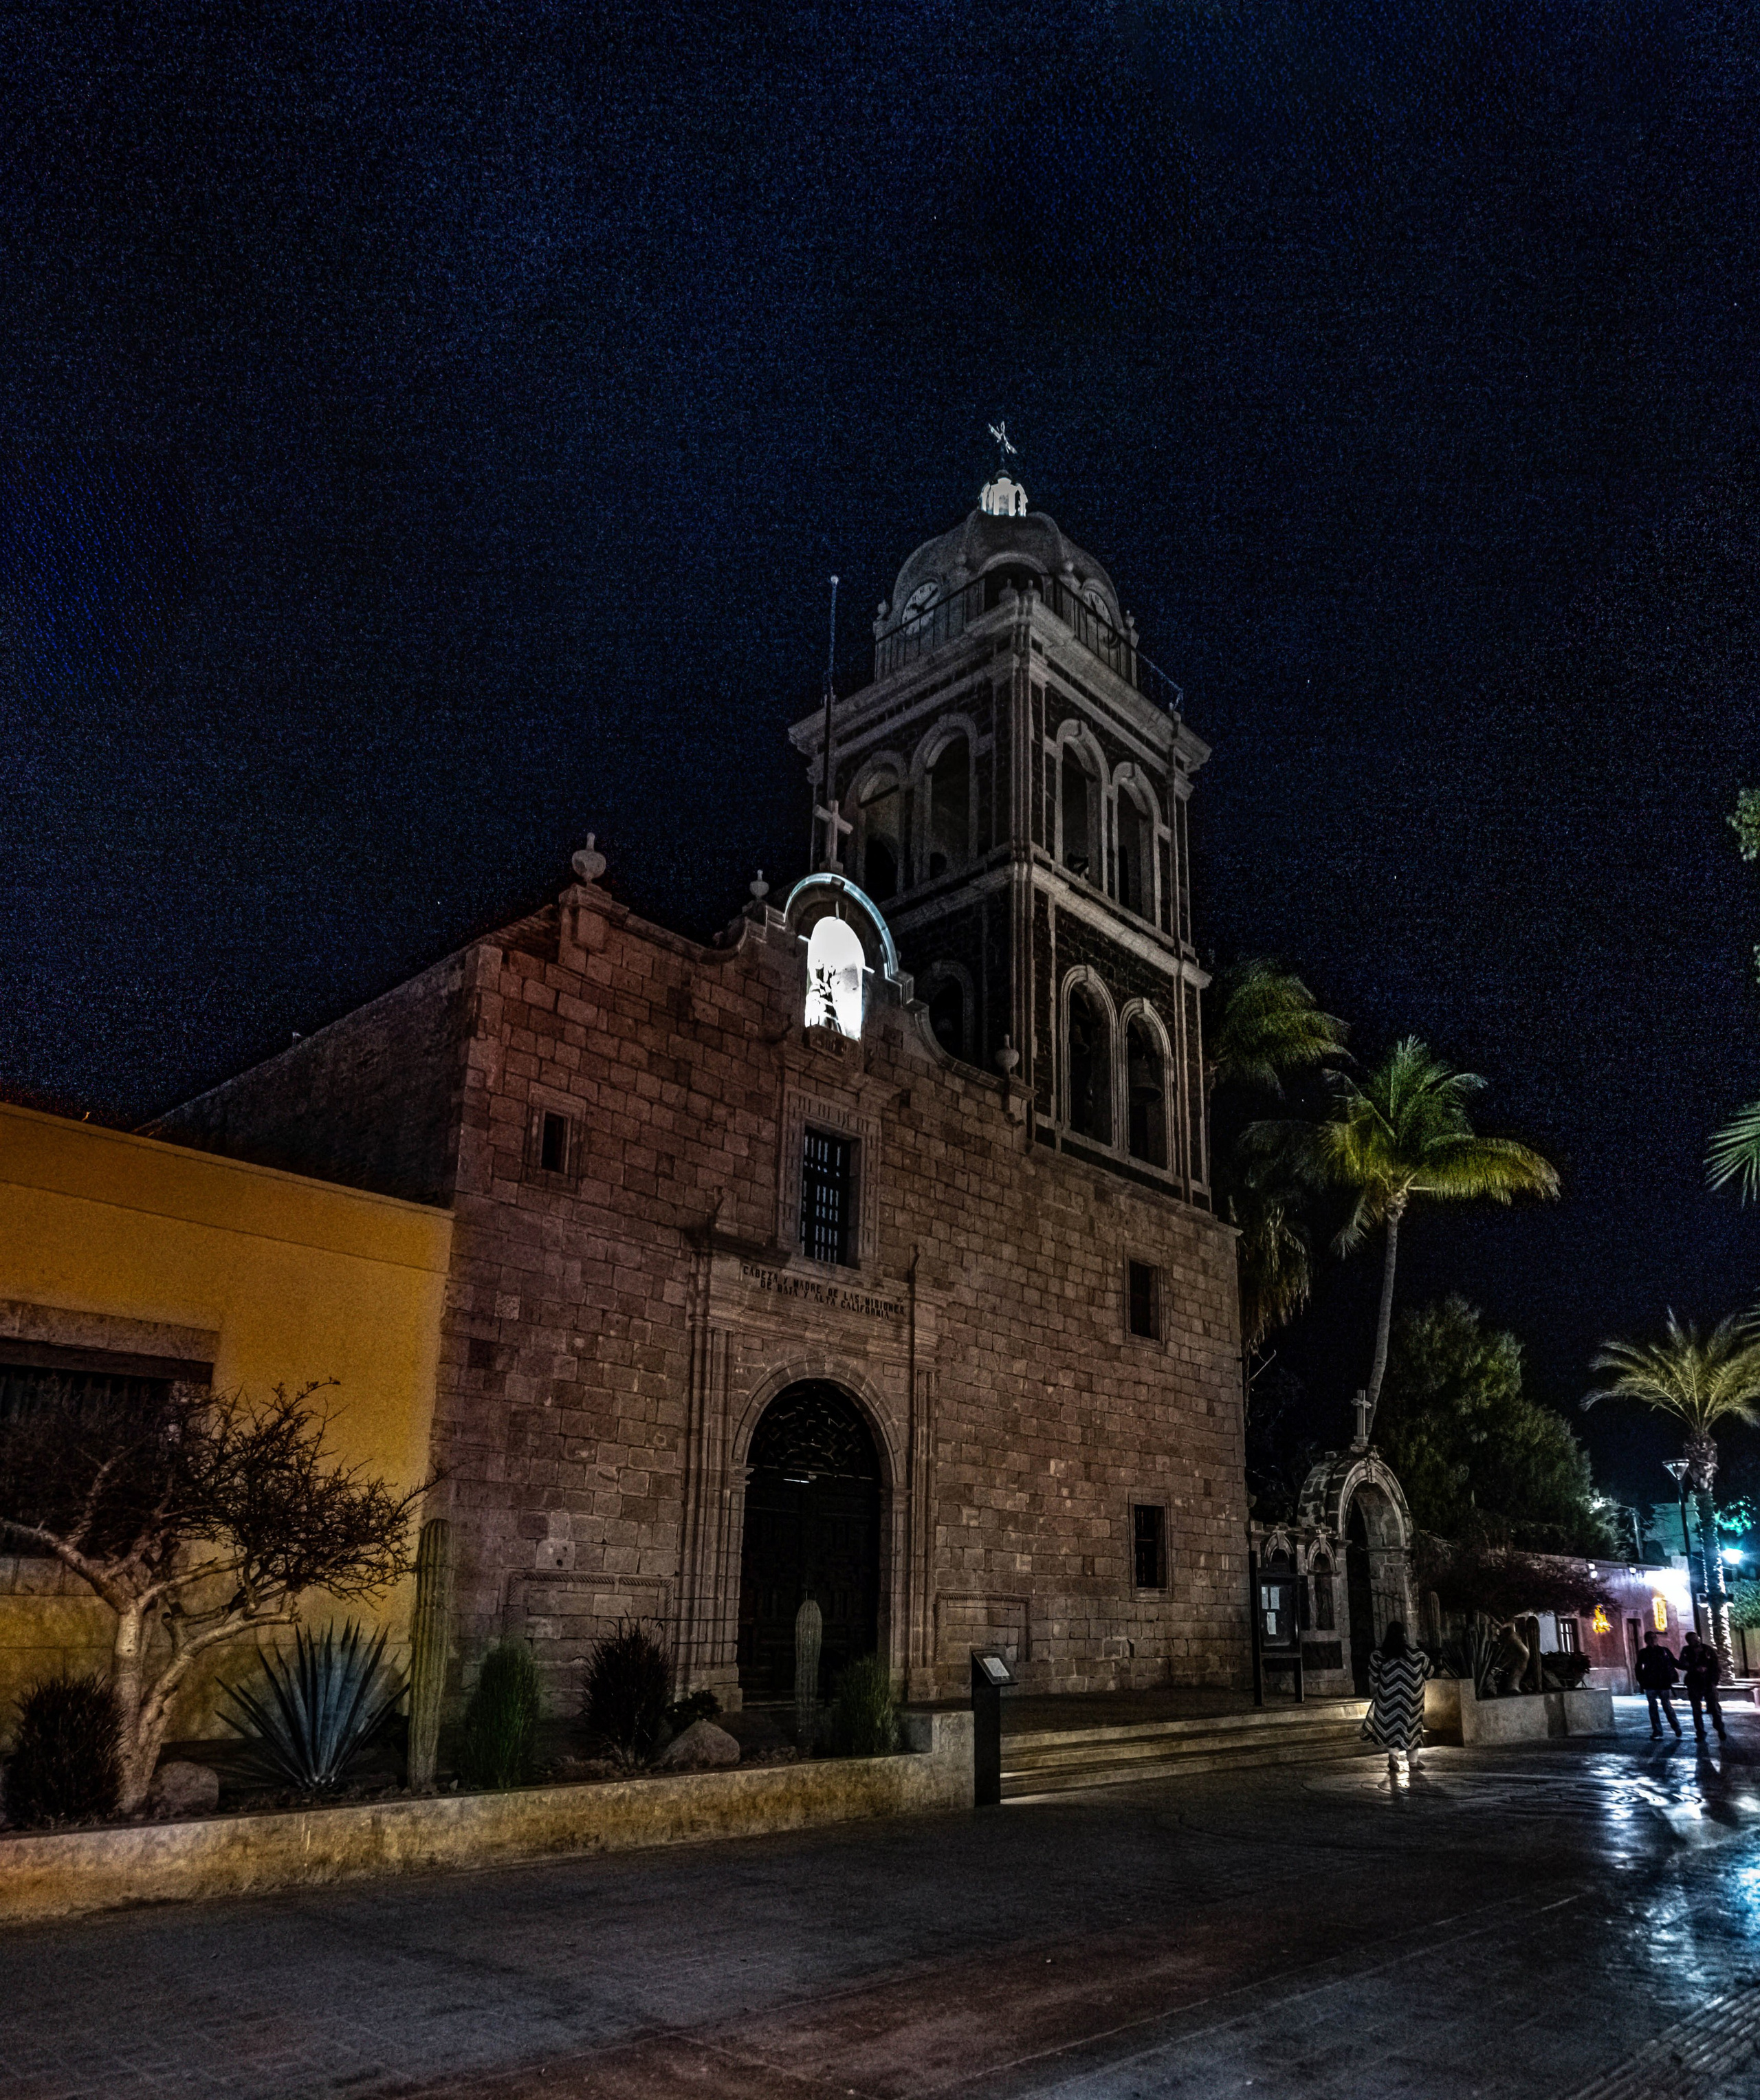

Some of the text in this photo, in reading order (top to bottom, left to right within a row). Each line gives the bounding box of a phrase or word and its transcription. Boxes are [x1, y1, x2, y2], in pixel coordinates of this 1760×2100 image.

[743, 1265, 778, 1282] CABEZA
[783, 1276, 788, 1284] Y
[793, 1279, 822, 1294] MADRE
[828, 1288, 838, 1298] DE
[844, 1291, 859, 1304] LAS
[760, 1280, 890, 1320] DE BAJA Y ALTA CALIFORNIA
